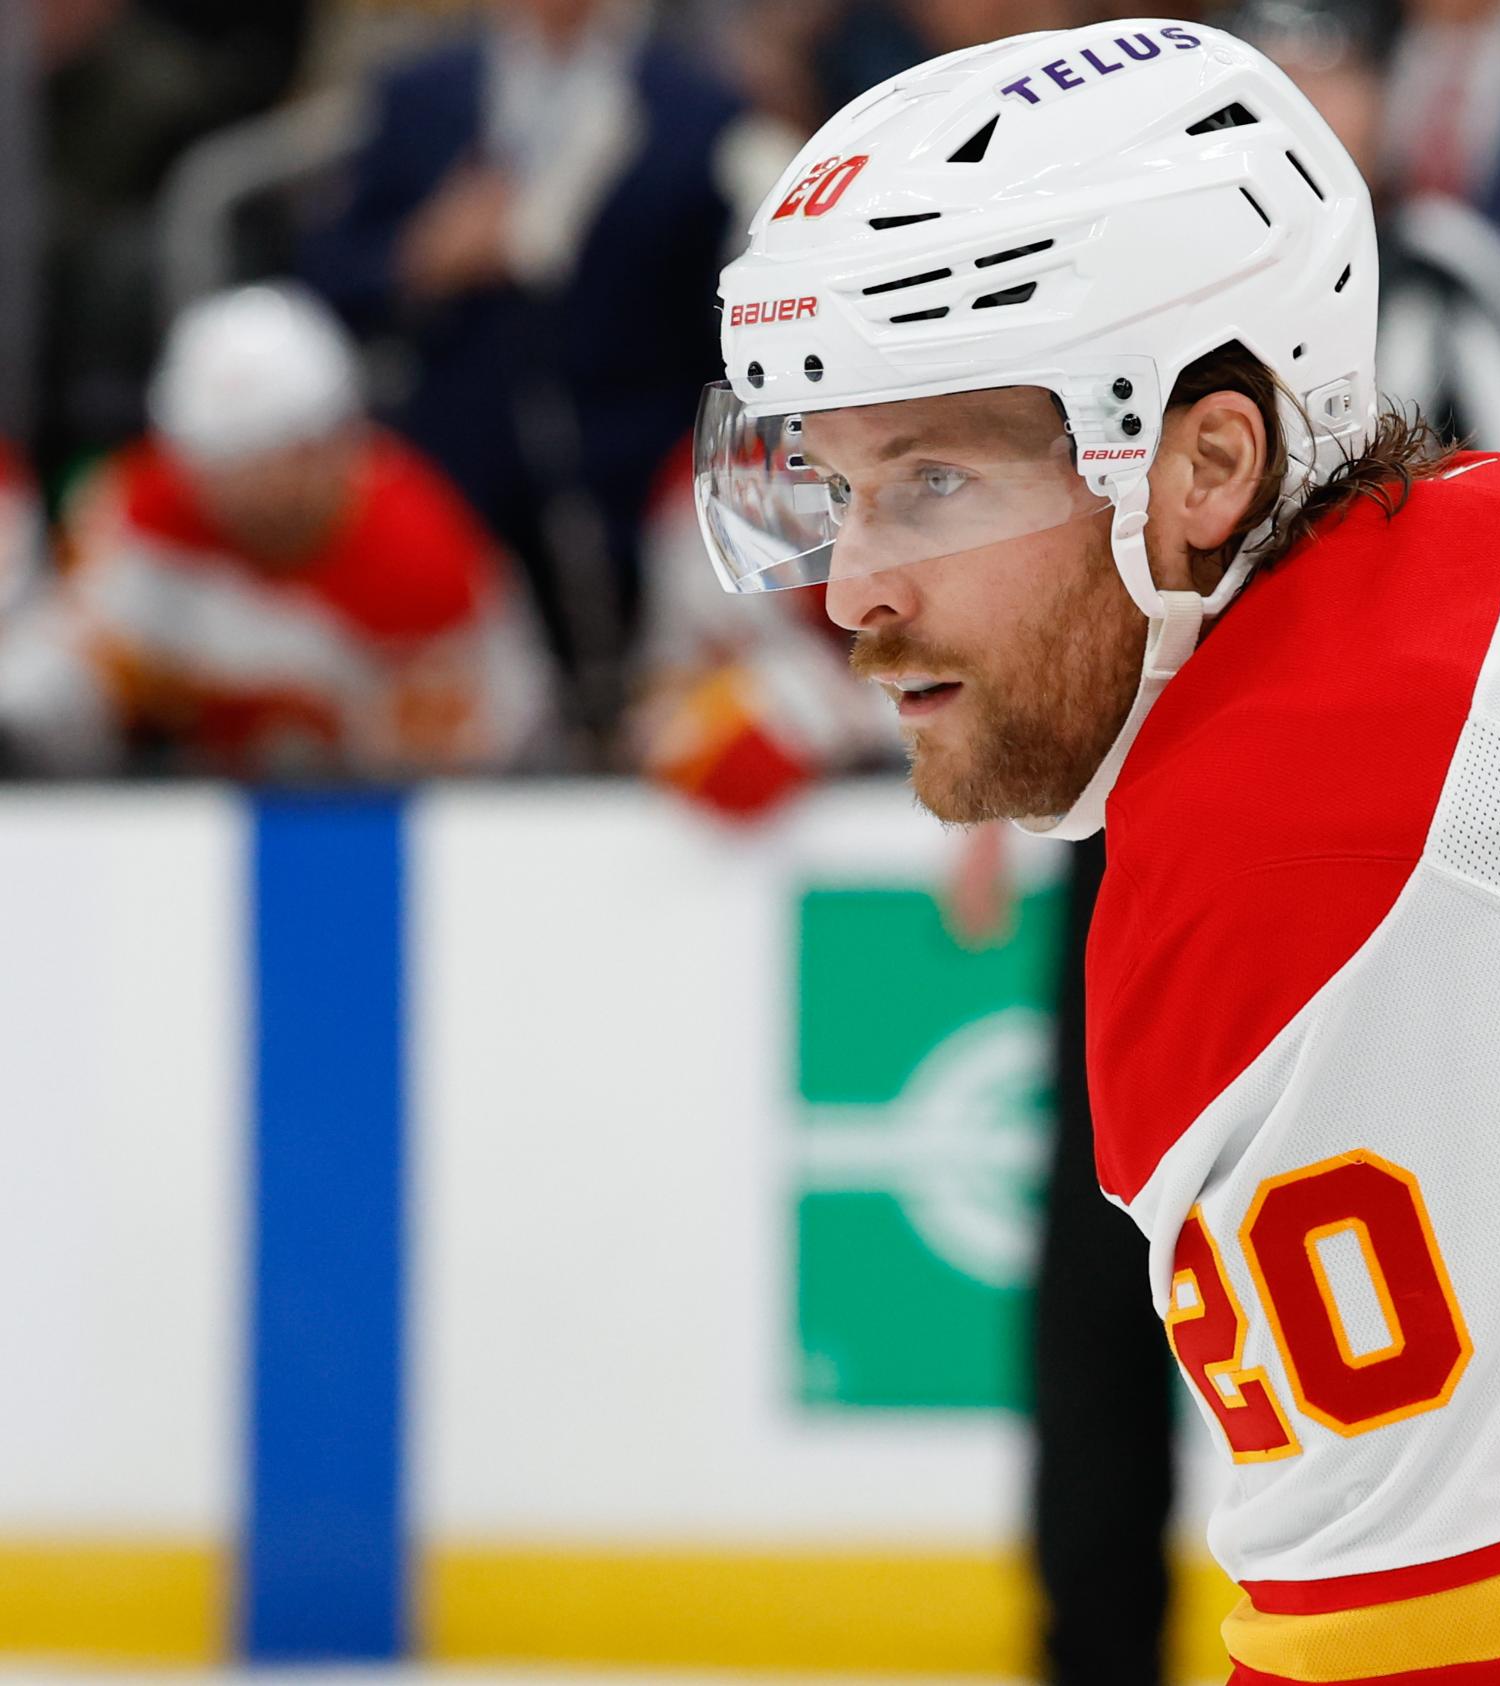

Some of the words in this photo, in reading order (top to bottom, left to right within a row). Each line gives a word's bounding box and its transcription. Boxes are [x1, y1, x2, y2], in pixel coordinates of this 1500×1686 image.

[1000, 27, 1201, 105] TELUS
[769, 153, 872, 222] 20
[730, 296, 818, 327] BAUER
[1082, 449, 1147, 460] BAUER
[1164, 1147, 1475, 1465] 20
